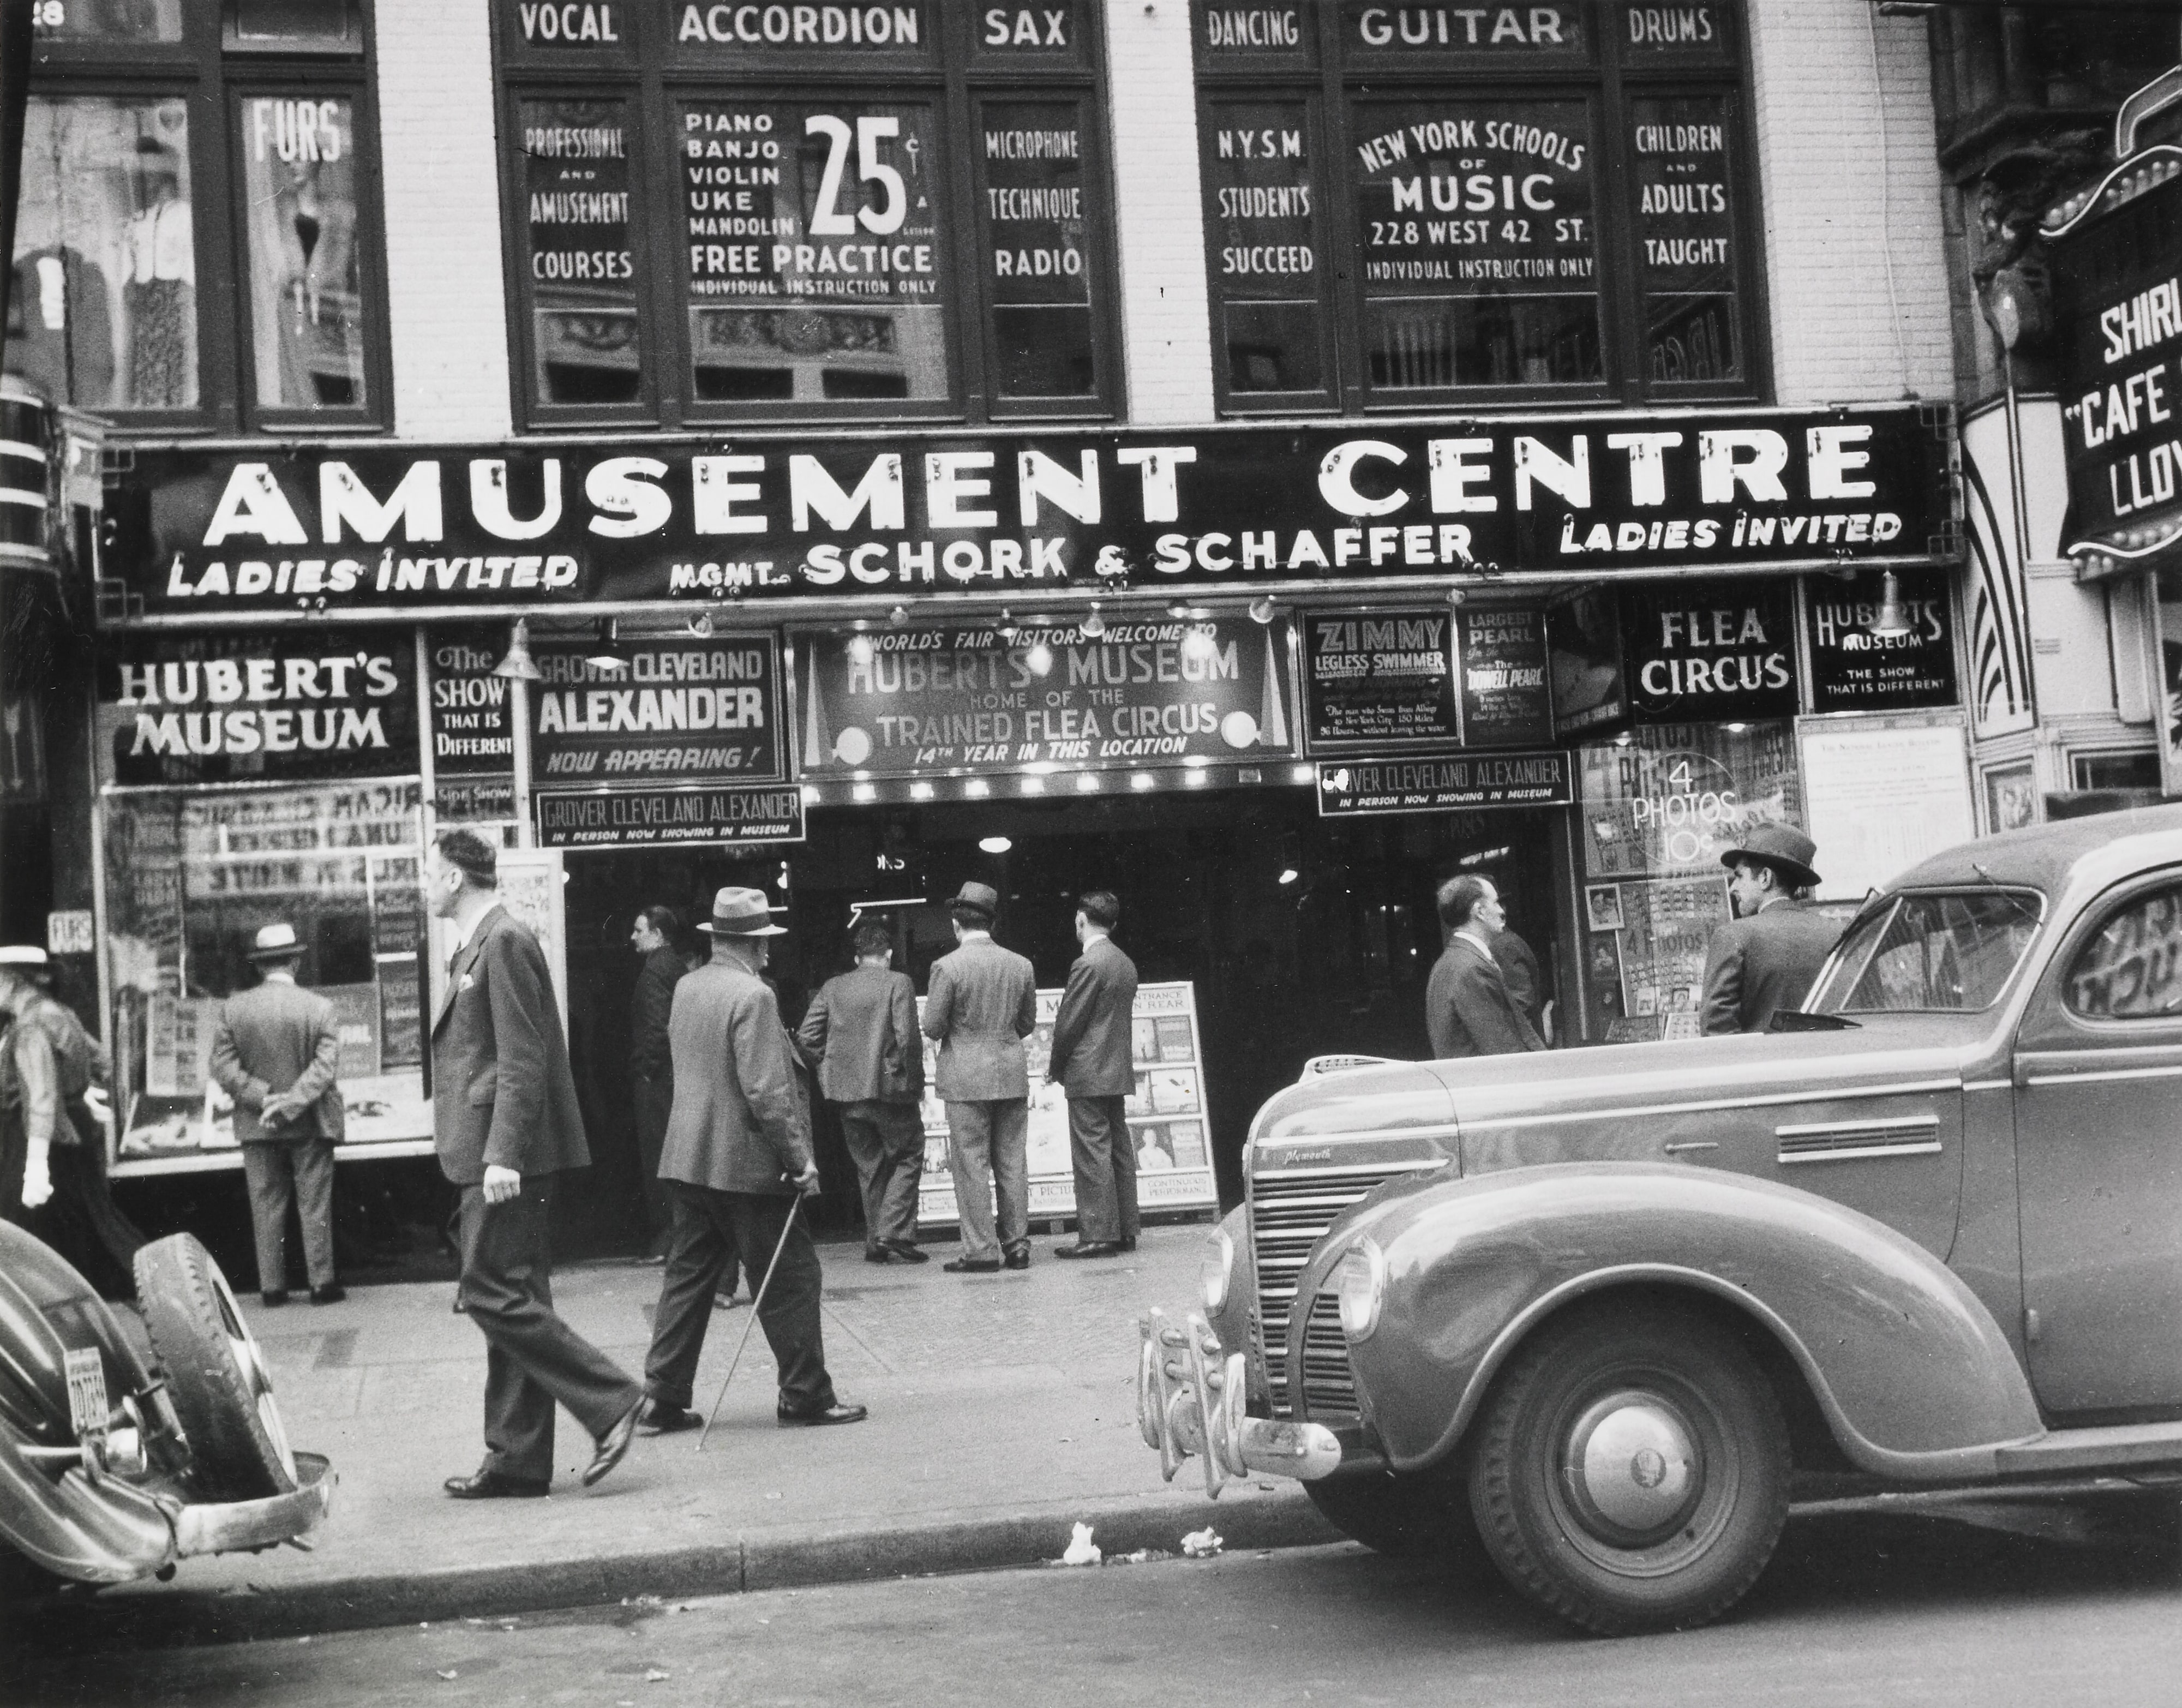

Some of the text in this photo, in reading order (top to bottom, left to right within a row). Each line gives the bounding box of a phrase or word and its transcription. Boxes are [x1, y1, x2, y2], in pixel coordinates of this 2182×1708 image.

[521, 3, 618, 41] VOCAL
[679, 5, 918, 43] ACCORDION
[985, 9, 1065, 45] SAX
[1208, 11, 1298, 46] DANCING
[1360, 8, 1563, 45] GUITAR
[1628, 8, 1712, 42] DRUMS
[253, 100, 339, 162] FURS
[686, 113, 772, 132] PIANO
[525, 128, 625, 158] PROFESSIONAL
[687, 140, 780, 159] BANJO
[986, 131, 1078, 158] MICROPHONE
[1358, 120, 1585, 173] NEW YORK SCHOOLS
[1636, 125, 1722, 152] CHILDREN
[560, 170, 596, 179] AND
[689, 166, 780, 185] VIOLIN
[1460, 159, 1486, 169] OF
[691, 191, 753, 211] UKE
[988, 188, 1081, 223] TECHNIQUE
[1218, 186, 1310, 218] STUDENTS
[1392, 174, 1555, 212] MUSIC
[1641, 184, 1725, 213] ADULTS
[530, 192, 628, 224] AMUSEMENT
[690, 217, 794, 236] MANDOLIN
[1371, 218, 1588, 245] 228 WEST 42 ST.
[532, 251, 633, 279] COURSES
[691, 244, 933, 273] FREE PRACTICE
[995, 248, 1081, 276] RADIO
[1222, 246, 1314, 273] SUCCEED
[1645, 238, 1728, 266] TAUGHT
[1366, 257, 1593, 279] INDIVIDUAL INSTRUCTION ONLY
[691, 279, 937, 295] INDIVIDUAL INSTRUCTION ONLY
[203, 425, 1876, 546] AMUSEMENT CENTRE
[1560, 511, 1902, 553] LADIES INVITED
[806, 537, 1068, 585] SCHORK
[1095, 546, 1128, 576] &
[1154, 524, 1474, 573] SCHAFFER
[167, 553, 578, 597] LADIES INVITED
[1468, 612, 1536, 627] LARGEST
[1661, 608, 1767, 649] FLEA
[955, 631, 994, 648] FAIR
[1008, 627, 1087, 647] VISITORS
[1101, 624, 1186, 644] WELCOME
[1316, 618, 1444, 653] ZIMMY
[1469, 628, 1536, 645] PEARL
[1842, 633, 1923, 651] MUSEUM
[436, 646, 492, 670] The
[632, 650, 763, 682] CLEVELAND
[1068, 639, 1238, 686] MUSEUM
[1315, 654, 1370, 673] LEGLESS
[1372, 650, 1447, 673] SWIMMER
[117, 651, 398, 706] HUBERT'S
[1640, 654, 1790, 696] CIRCUS
[1846, 666, 1916, 680] THE SHOW
[435, 677, 506, 708] SHOW
[970, 688, 1124, 710] HOME OF THE
[1826, 679, 1945, 696] THAT IS DIFFERENT
[442, 712, 501, 729] THAT IS
[538, 686, 764, 734] ALEXANDER
[130, 708, 389, 756] MUSEUM
[876, 702, 1218, 747] TRAINED FLEA CIRCUS
[436, 733, 512, 756] DIFFERENT
[963, 744, 1009, 762] YEAR
[1016, 742, 1039, 760] IN
[1048, 740, 1090, 759] THIS
[1100, 736, 1188, 757] LOCATION
[547, 751, 598, 772] NOW
[1323, 758, 1561, 794] GOVER CLEVELAND ALEXANDER
[1669, 760, 1693, 792] 4
[546, 792, 799, 827] GROVER CLEVELAND ALEXANDER
[1339, 788, 1552, 808] IN PERSON NOW SHOWING IN MUSEUM
[1633, 790, 1736, 829] PHOTOS
[552, 824, 790, 842] IN PERSON NOW SHOWING IN MUSEUM
[1134, 990, 1183, 1000] NTRANCE
[1148, 1000, 1184, 1009] REAR
[1148, 1177, 1207, 1188] CONTINUOUS
